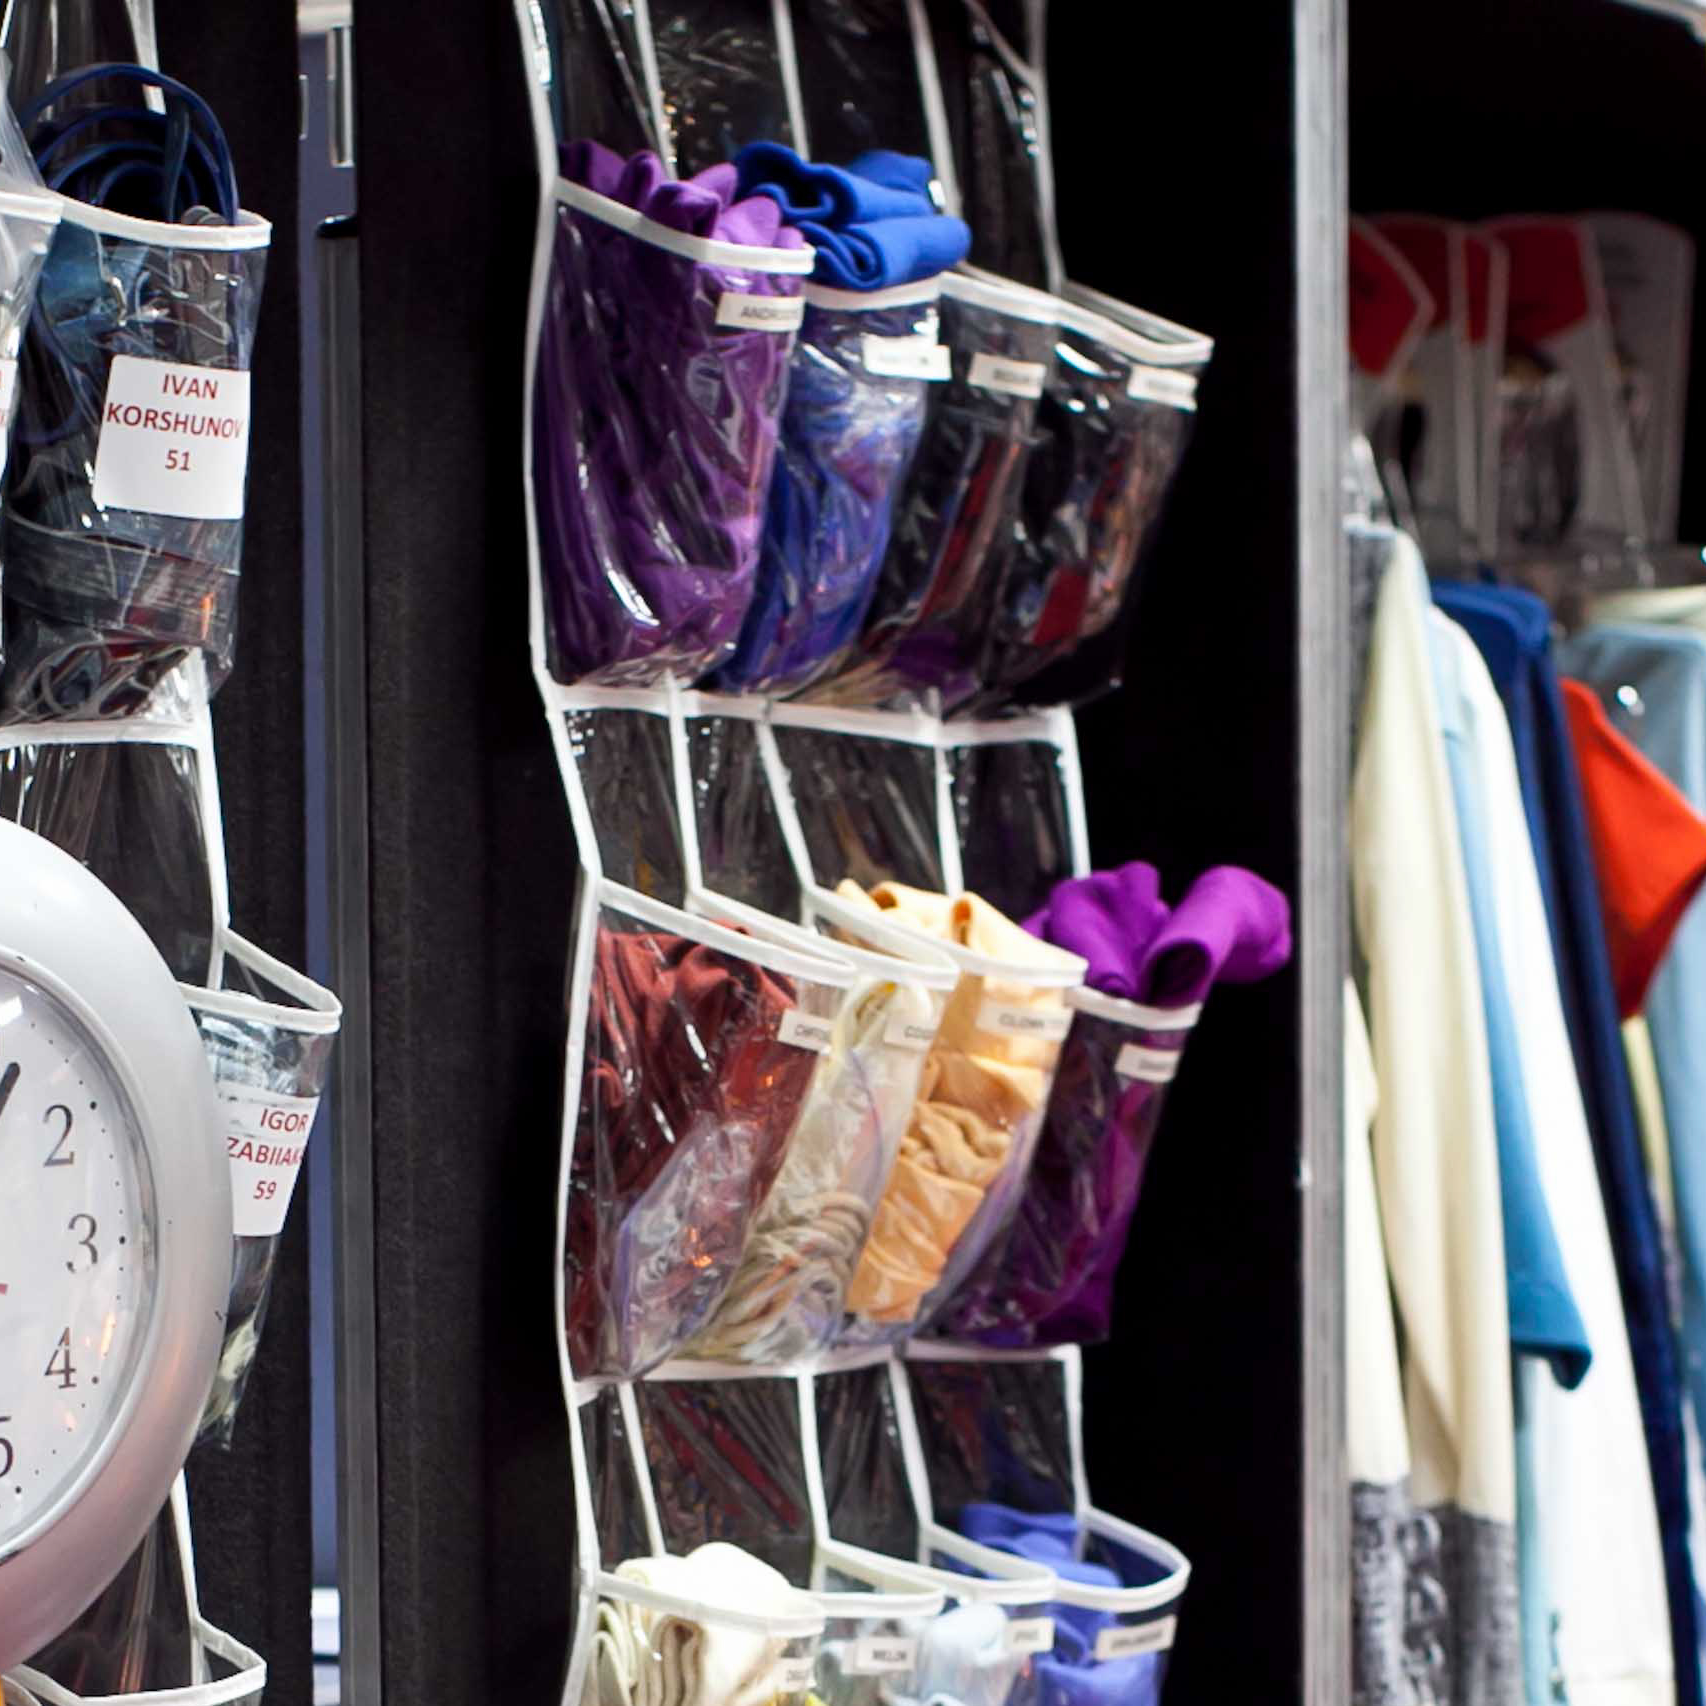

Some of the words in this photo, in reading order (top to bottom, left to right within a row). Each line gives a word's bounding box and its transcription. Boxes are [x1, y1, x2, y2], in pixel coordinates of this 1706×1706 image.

[162, 373, 219, 400] IVAN
[165, 449, 191, 471] 51
[260, 1107, 310, 1133] IGOR
[41, 1104, 76, 1168] 2
[253, 1180, 277, 1200] 59
[64, 1212, 100, 1276] 3
[43, 1326, 78, 1391] 4
